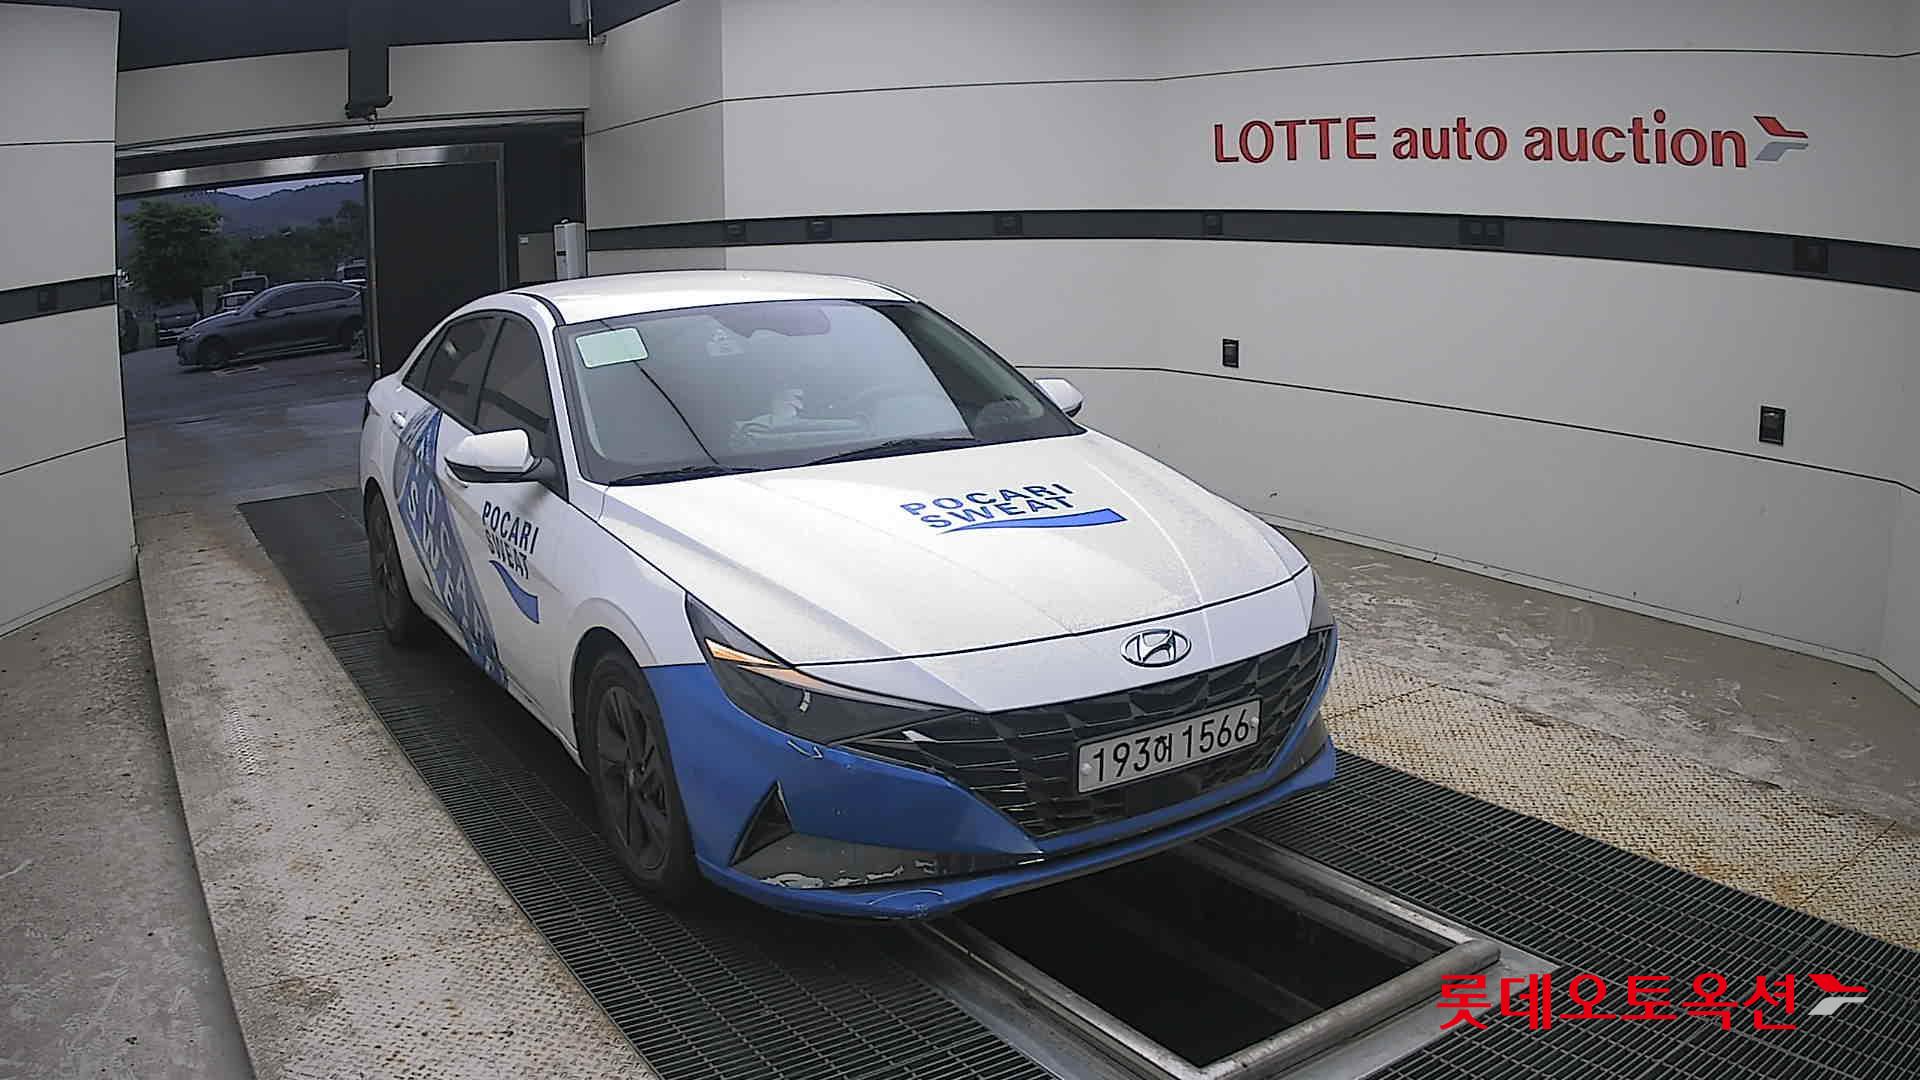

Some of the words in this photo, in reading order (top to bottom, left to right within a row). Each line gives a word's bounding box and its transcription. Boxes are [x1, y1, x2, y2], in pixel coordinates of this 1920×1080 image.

[1213, 116, 1377, 164] LOTTE
[1392, 117, 1508, 161] auto
[1523, 109, 1748, 168] auction
[901, 483, 1073, 515] POCARI
[921, 496, 1074, 529] SWEAT
[482, 500, 539, 554] POCARI
[485, 529, 529, 580] SWEAT
[1093, 733, 1172, 782] 193허
[1182, 709, 1250, 758] 1566
